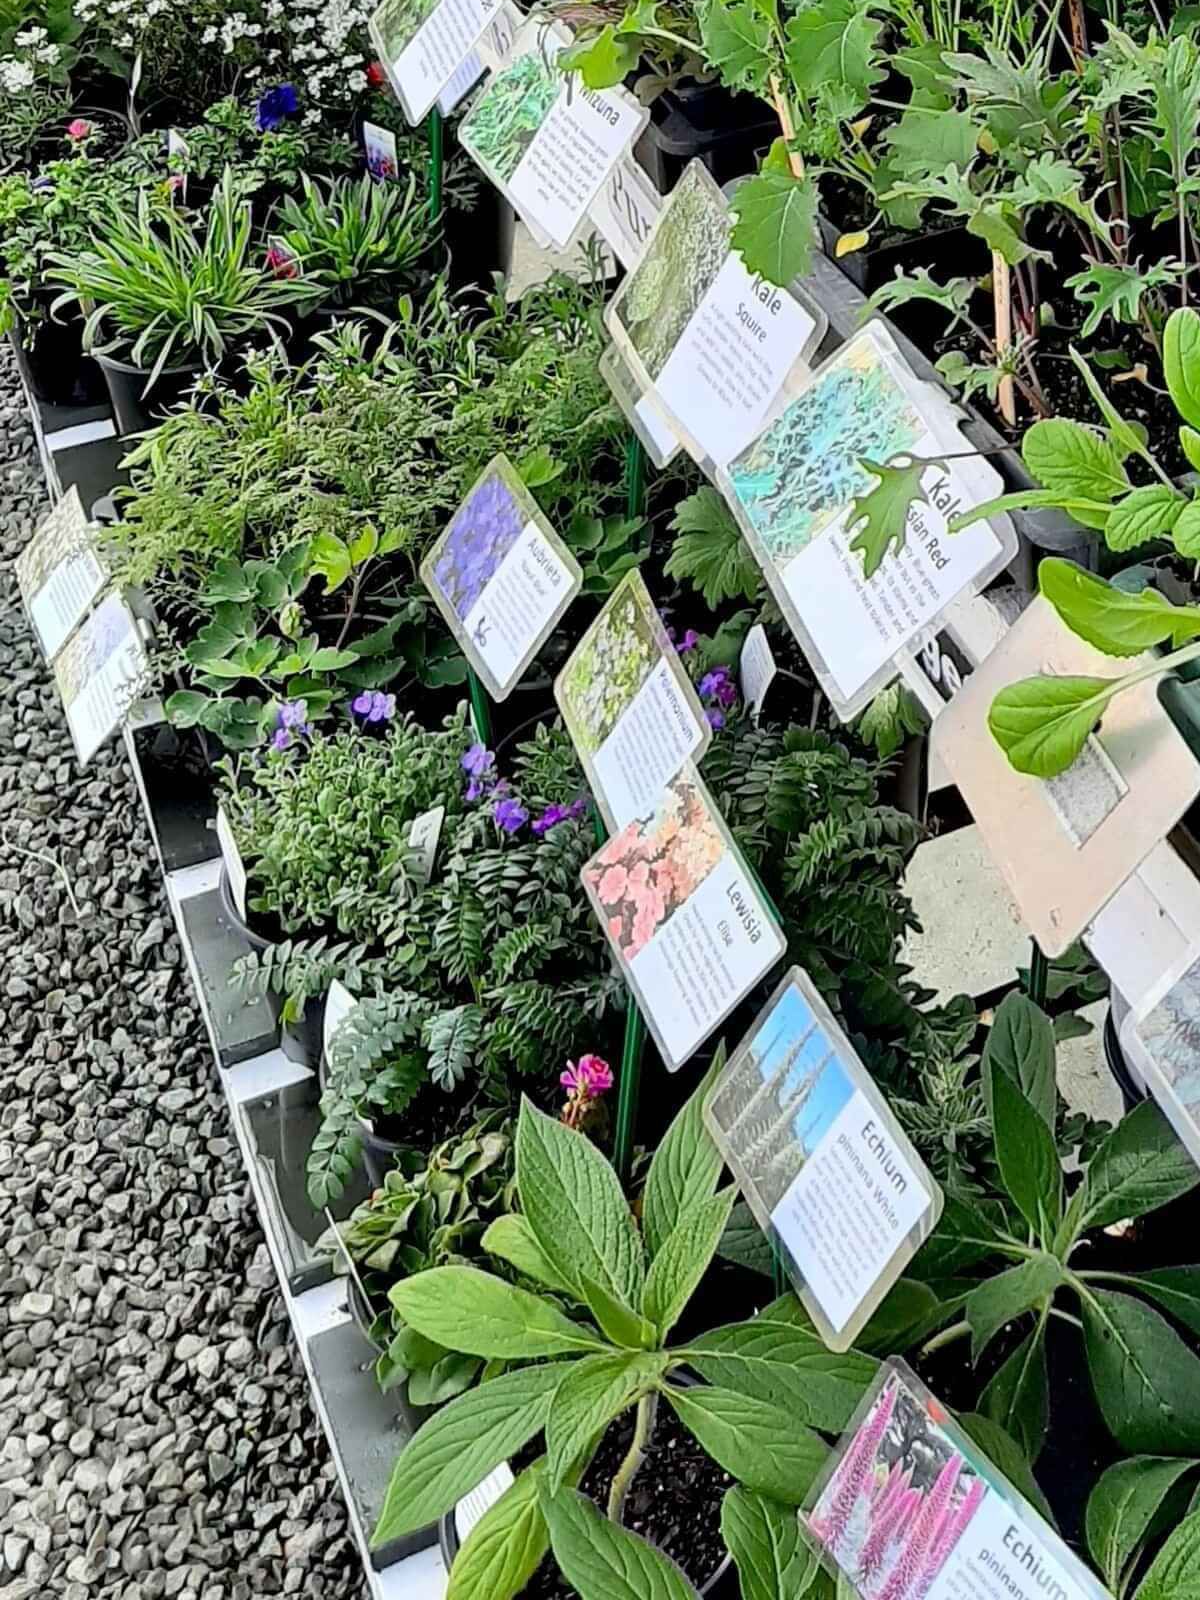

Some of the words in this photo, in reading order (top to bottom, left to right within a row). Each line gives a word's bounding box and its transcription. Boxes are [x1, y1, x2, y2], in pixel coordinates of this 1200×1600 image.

[751, 272, 783, 316] Kale
[735, 301, 768, 344] Squire
[928, 476, 964, 526] Kale
[905, 504, 930, 543] ssian
[926, 537, 952, 571] Red
[528, 538, 562, 587] Aubrieta
[716, 918, 734, 948] Elise
[725, 878, 762, 945] Lewisia
[861, 1119, 908, 1196] Echium
[873, 1186, 900, 1231] White
[1002, 1523, 1070, 1600] Echium
